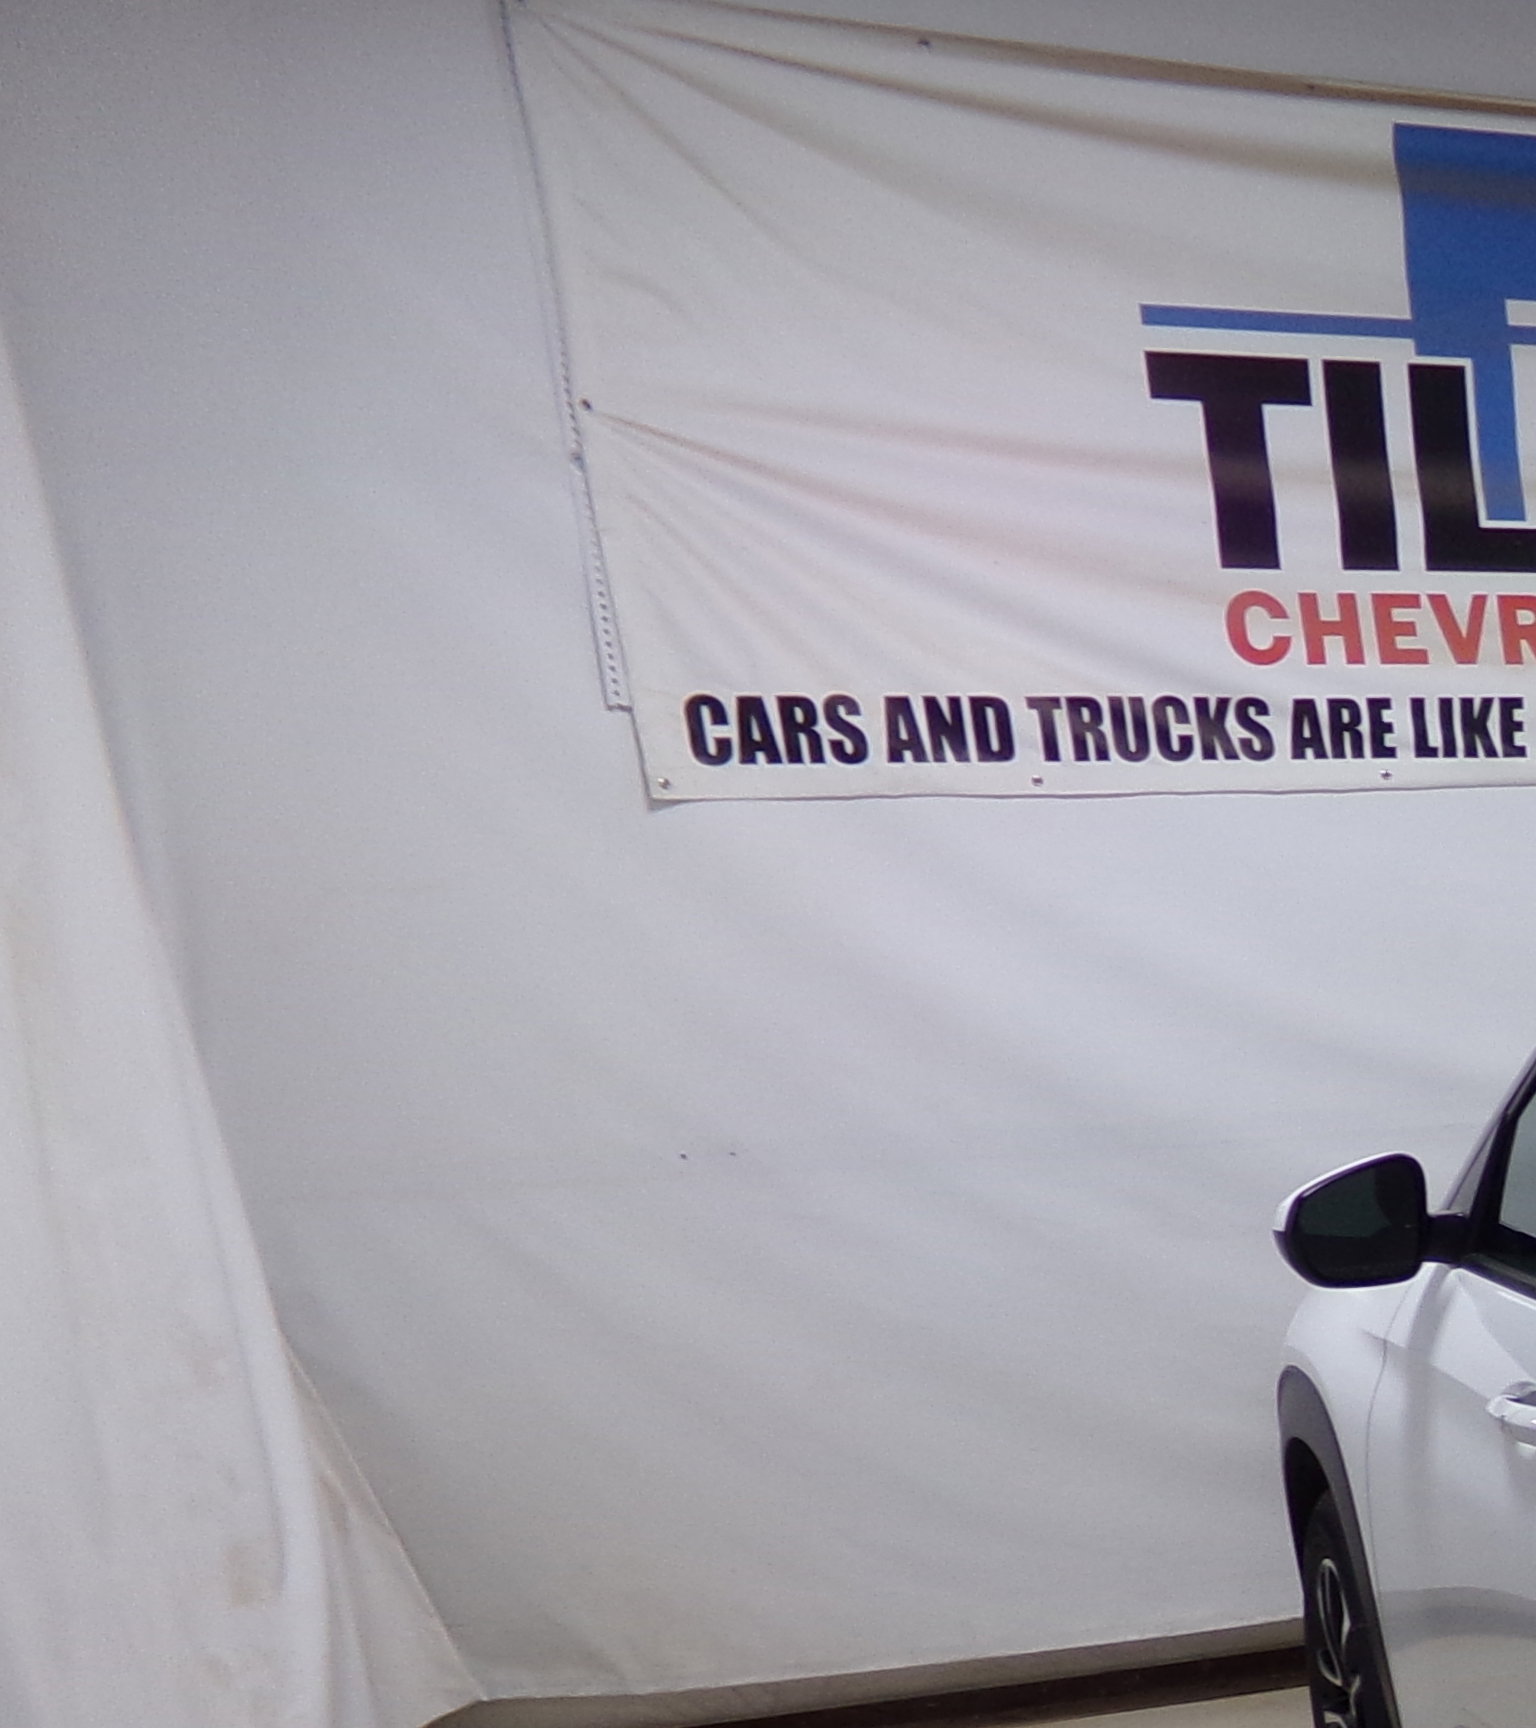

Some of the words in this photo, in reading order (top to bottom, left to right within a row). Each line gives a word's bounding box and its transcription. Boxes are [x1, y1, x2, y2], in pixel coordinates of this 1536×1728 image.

[684, 693, 869, 767] CARS
[885, 695, 1016, 764] AND
[1026, 694, 1275, 763] TRUCKS
[1290, 696, 1398, 761] ARE
[1409, 696, 1528, 759] LIKE
